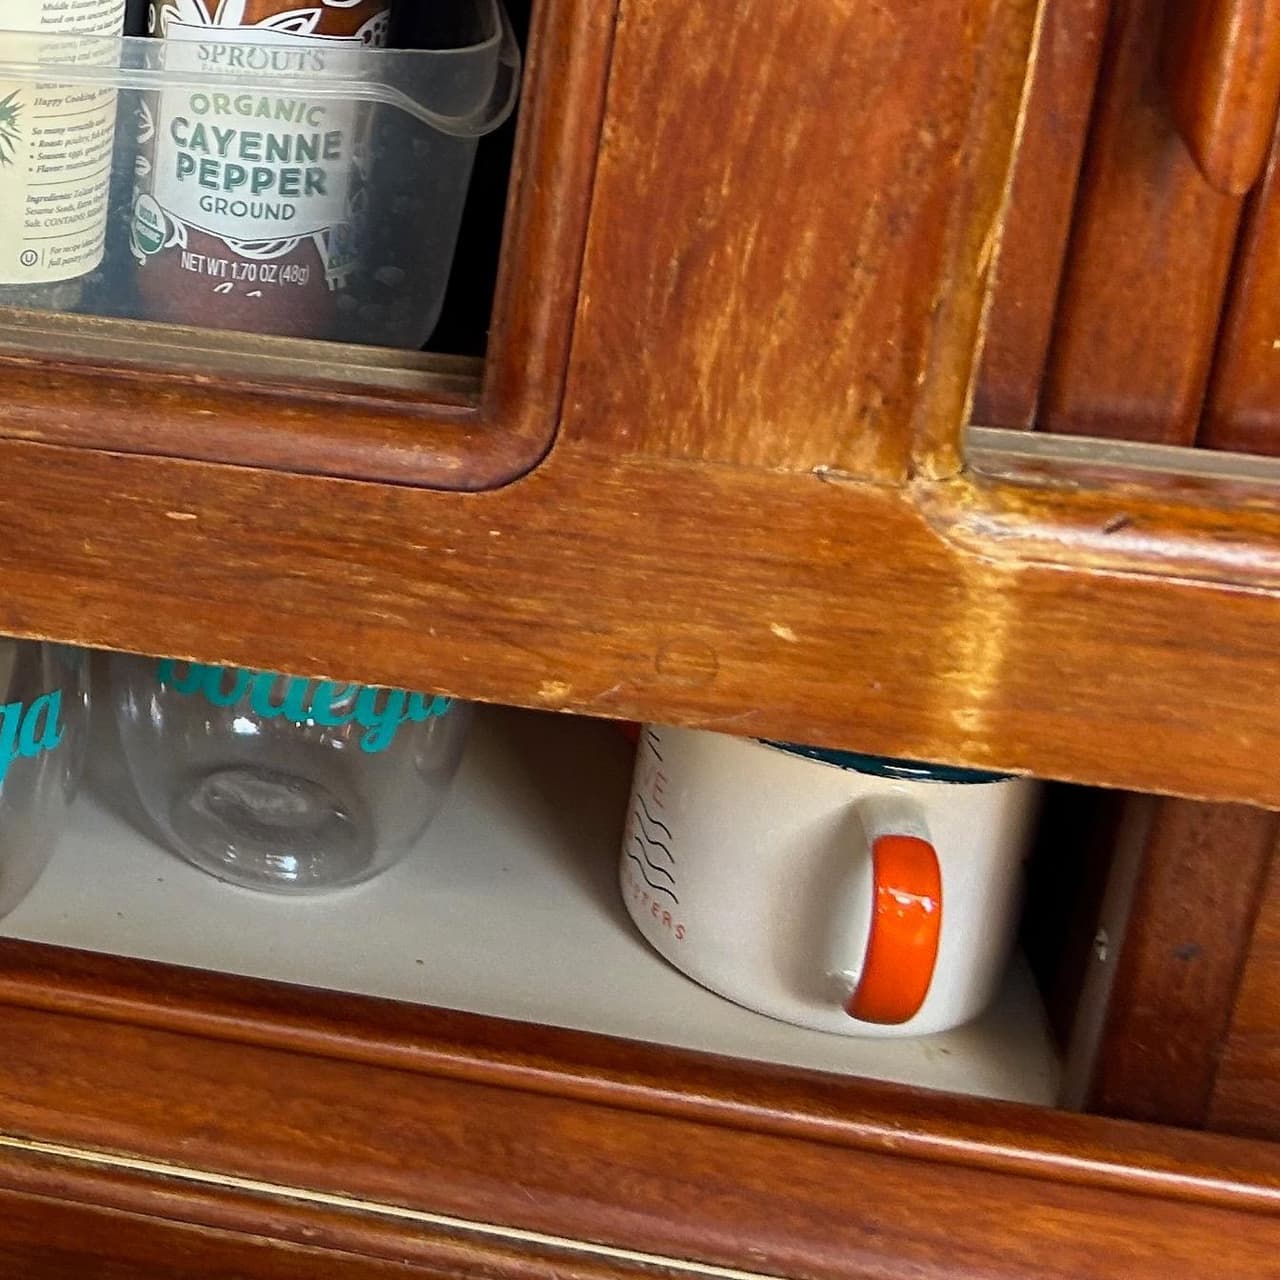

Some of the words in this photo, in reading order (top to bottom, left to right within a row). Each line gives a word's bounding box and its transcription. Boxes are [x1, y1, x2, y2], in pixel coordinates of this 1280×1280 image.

[198, 44, 326, 71] SPROUTS
[33, 97, 63, 107] Happy
[190, 93, 326, 127] ORGANIC
[170, 116, 343, 163] CAYENNE
[176, 152, 328, 198] PEPPER
[199, 195, 296, 221] GROUND
[181, 251, 204, 273] NET
[206, 259, 228, 278] WT
[230, 261, 256, 280] 1.70
[259, 264, 278, 283] OZ
[278, 265, 310, 287] (48g)
